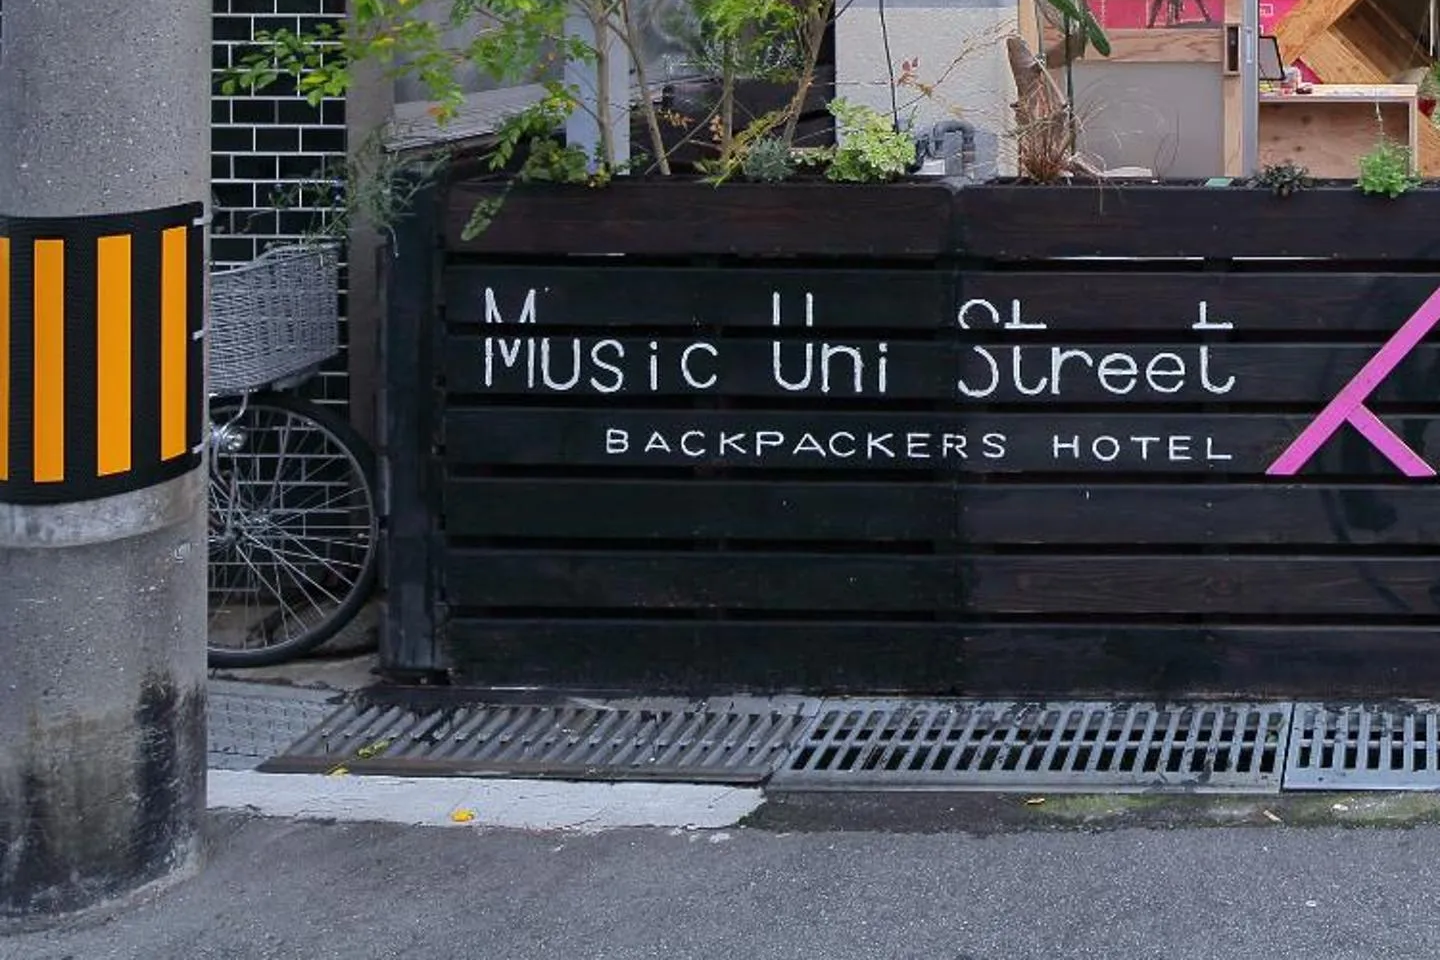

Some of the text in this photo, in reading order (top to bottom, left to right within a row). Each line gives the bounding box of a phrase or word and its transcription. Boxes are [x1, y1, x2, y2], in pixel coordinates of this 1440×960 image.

[772, 291, 889, 394] Uni
[957, 298, 1237, 398] Street
[606, 428, 1233, 462] BACKPACKERS HOTEL
